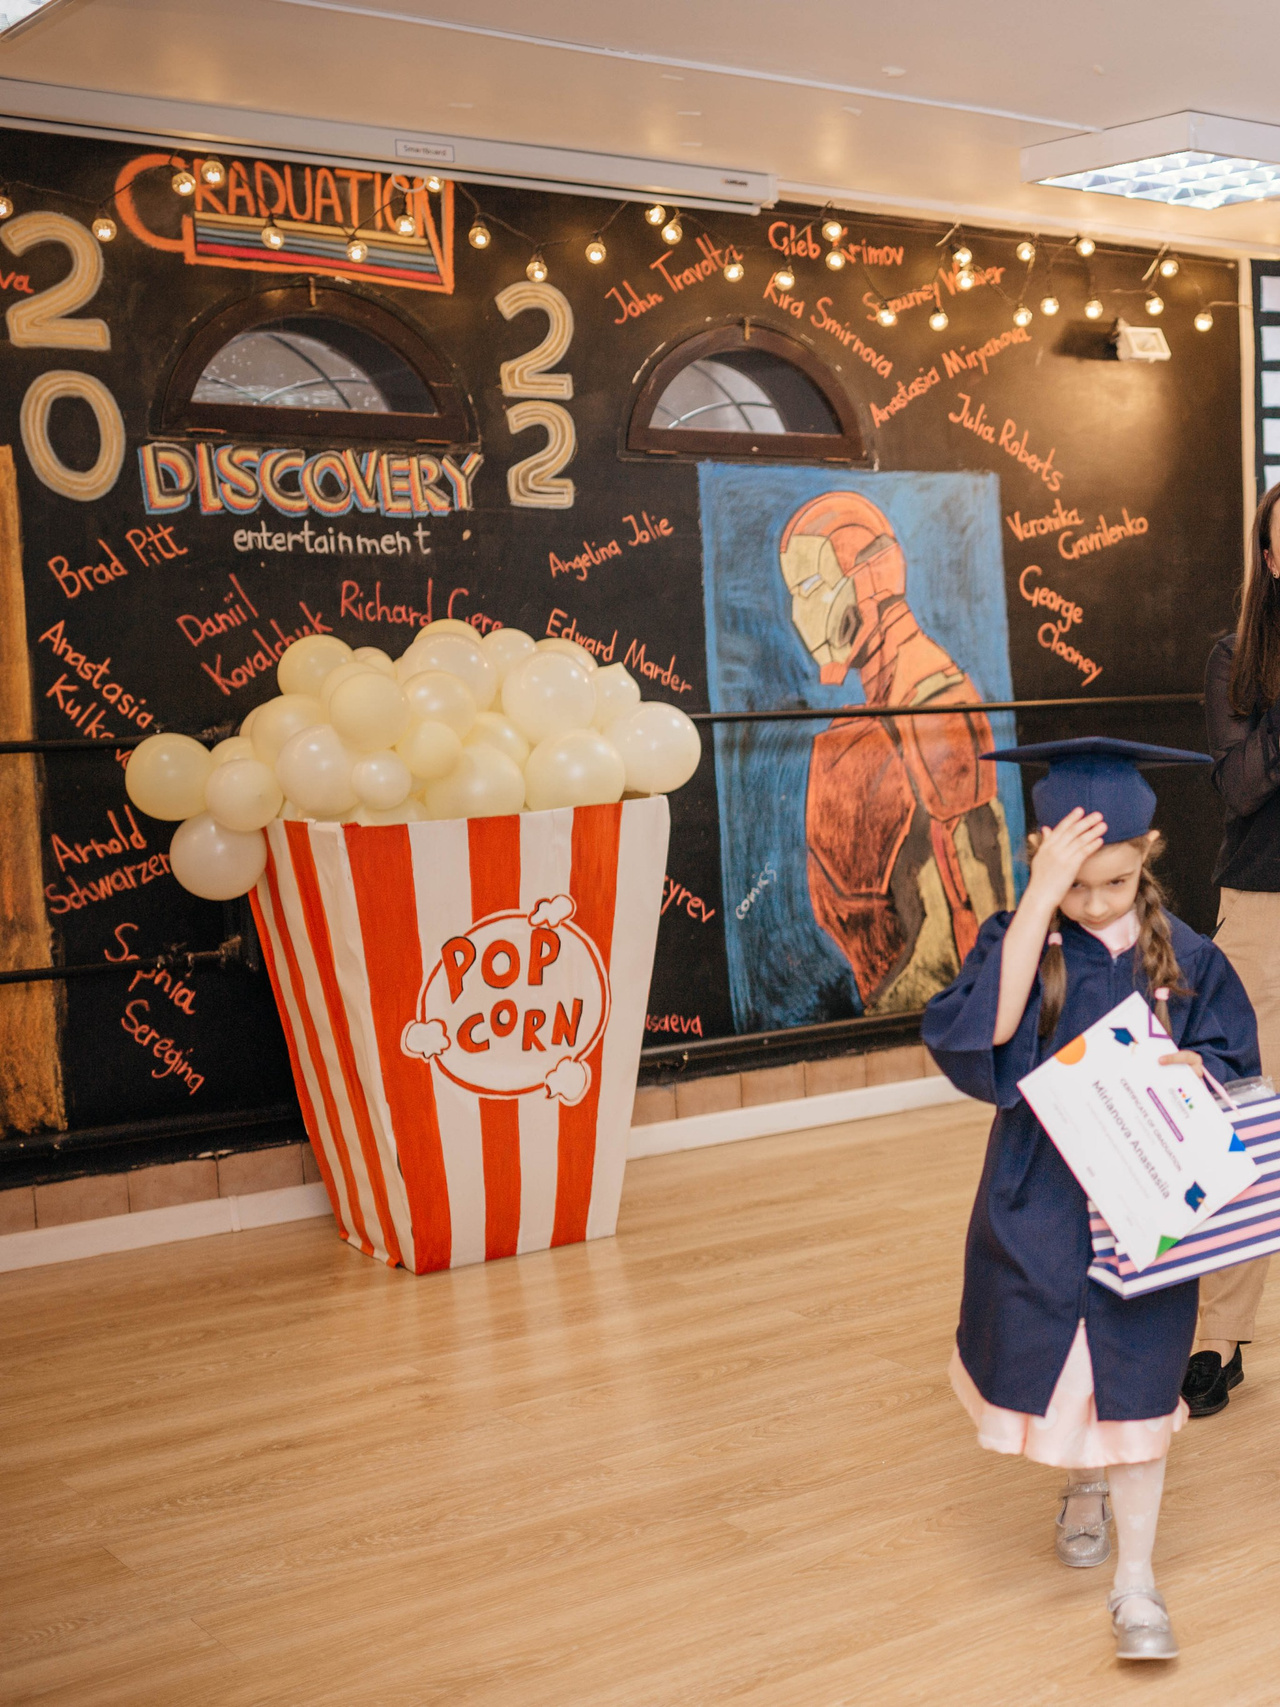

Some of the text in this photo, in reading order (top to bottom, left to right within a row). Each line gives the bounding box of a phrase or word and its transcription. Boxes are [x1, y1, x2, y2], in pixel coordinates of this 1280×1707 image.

[114, 152, 455, 295] GRADUATION
[768, 221, 821, 260] Gleb
[604, 280, 664, 325] John
[763, 272, 893, 379] Kira Smirnova
[494, 281, 574, 400] 2
[869, 366, 941, 428] Anastasia
[506, 400, 577, 510] 2
[948, 392, 1064, 492] Julia Roberts
[137, 442, 484, 518] DISCOVERY
[233, 520, 432, 555] entertainment
[549, 511, 674, 581] Angelina Jolie
[1006, 498, 1084, 542] Veronika
[1058, 507, 1149, 560] Gavrilenko
[48, 523, 188, 598] Brad Pitt
[340, 578, 433, 627] Richard
[1019, 565, 1083, 633] George
[38, 620, 153, 729] Anastasia
[545, 607, 692, 694] Edward Marder
[1037, 623, 1103, 687] Clooney
[51, 804, 147, 872] Arnold
[441, 927, 560, 1004] POP
[121, 999, 205, 1096] Seregina
[456, 998, 583, 1054] CORN
[1092, 1080, 1132, 1139] Mirianova
[1130, 1140, 1170, 1200] Anastasiia
[1120, 1078, 1148, 1119] CERTIFICATE
[1153, 1128, 1182, 1172] GRADUATION
